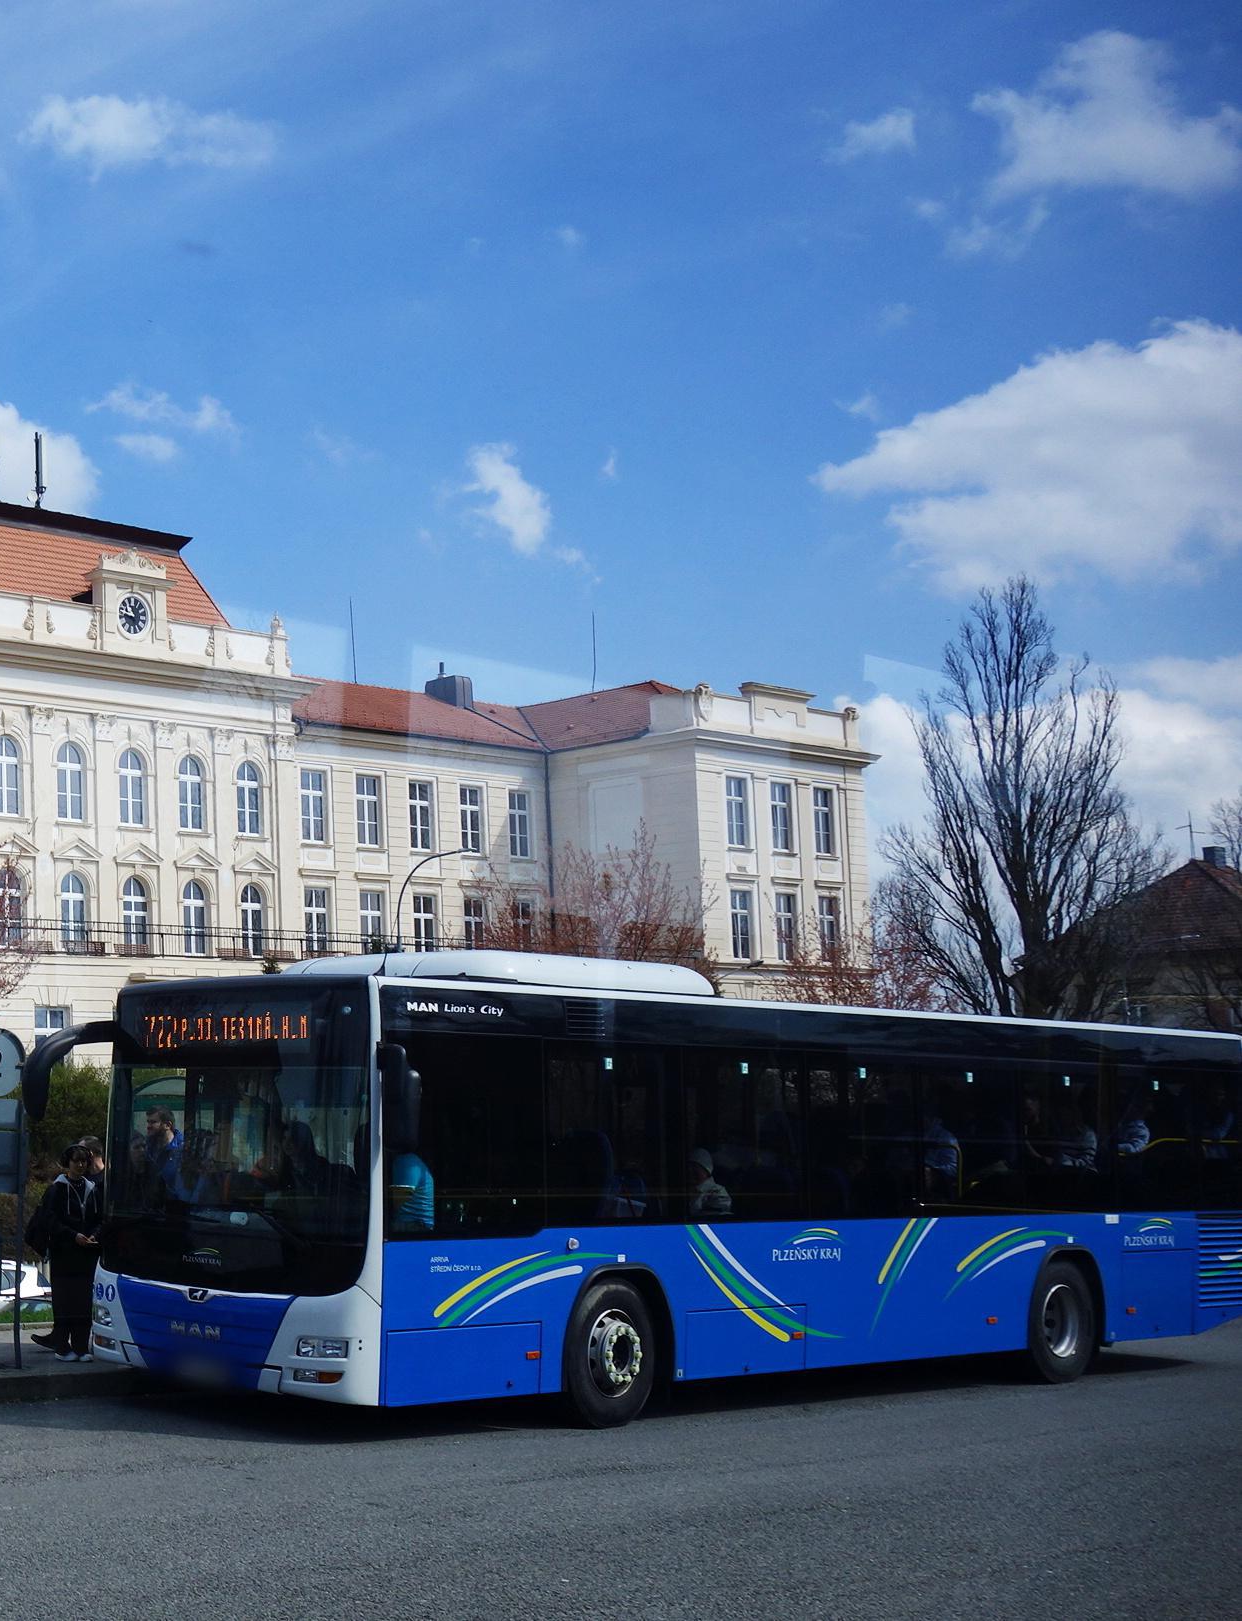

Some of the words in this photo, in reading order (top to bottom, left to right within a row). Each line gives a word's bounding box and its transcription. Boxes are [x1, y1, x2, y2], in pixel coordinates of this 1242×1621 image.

[406, 1001, 439, 1013] MAN
[444, 1003, 475, 1014] Lion's
[480, 1005, 504, 1017] City
[772, 1246, 819, 1261] PLZEŇSKÝ
[820, 1247, 841, 1261] KRAJ
[170, 1320, 221, 1341] MAN
